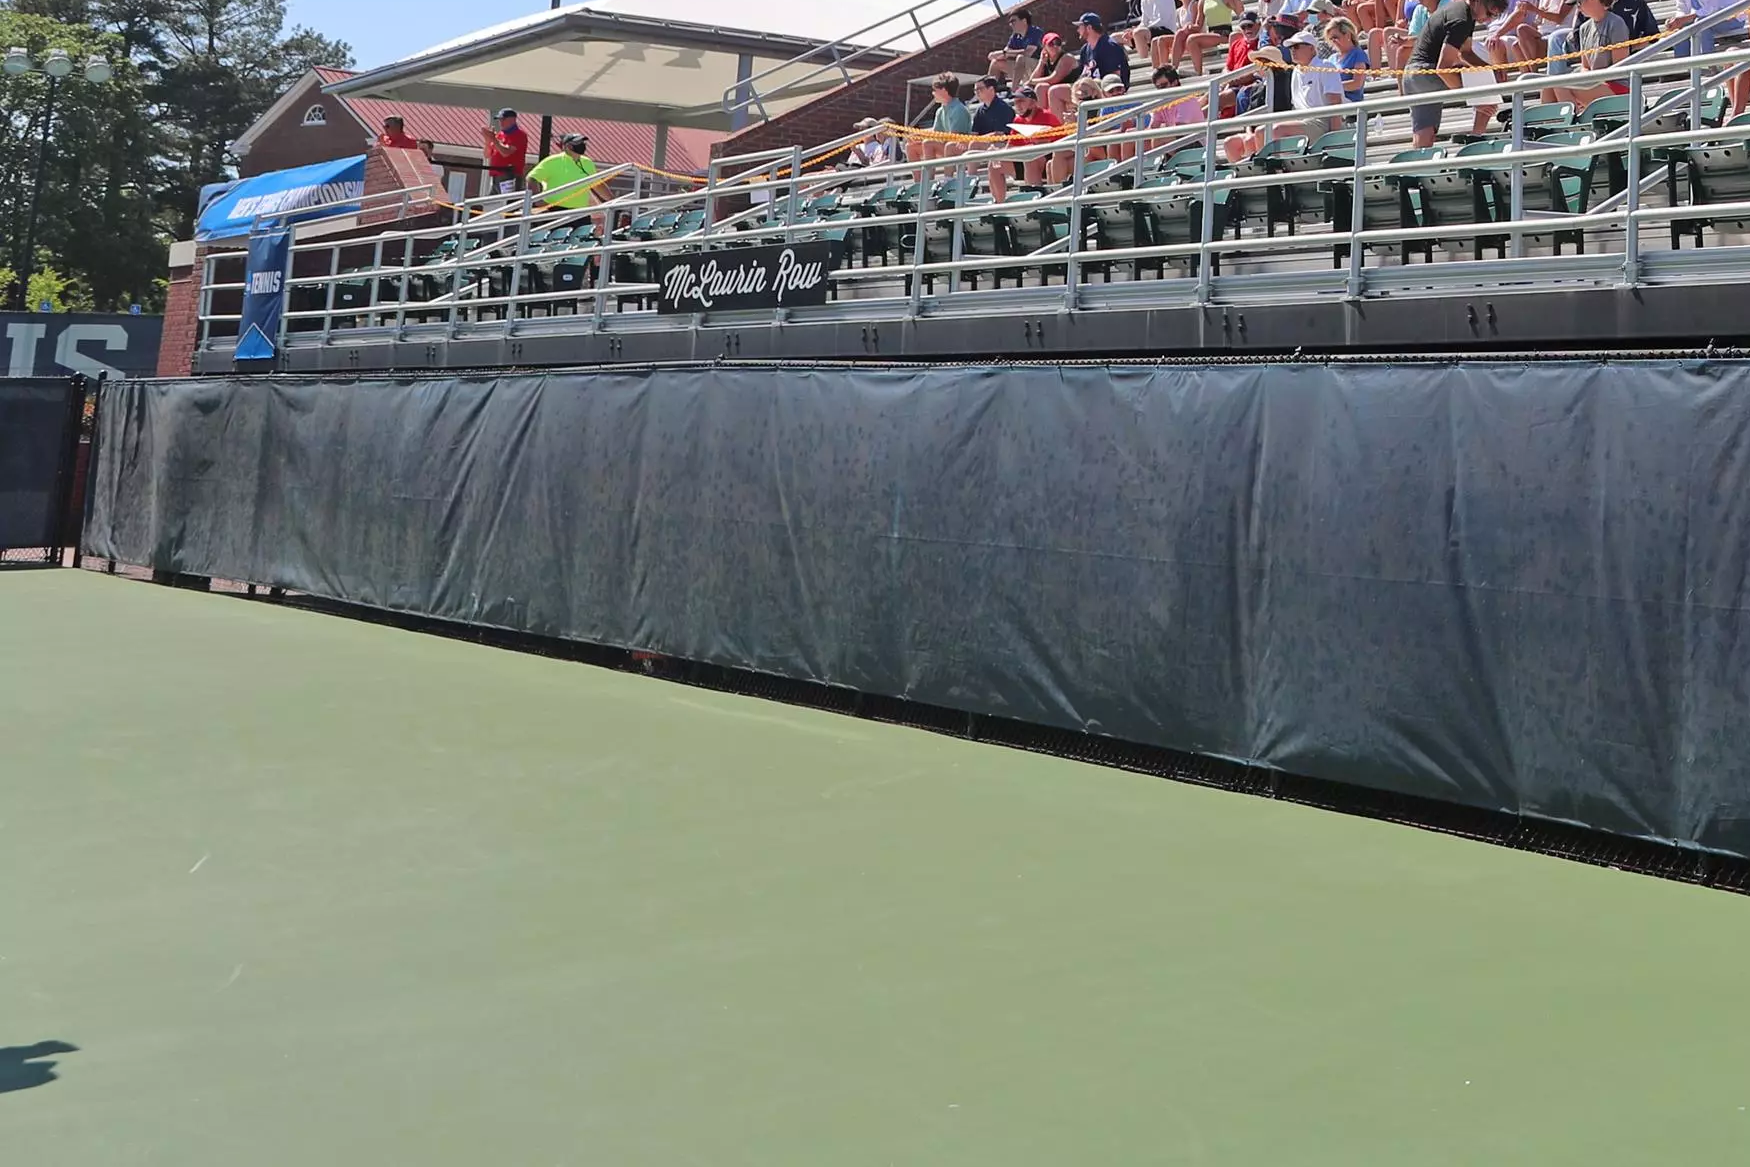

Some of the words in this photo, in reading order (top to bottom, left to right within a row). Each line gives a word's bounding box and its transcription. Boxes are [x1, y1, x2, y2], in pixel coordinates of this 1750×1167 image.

[251, 271, 281, 294] TENNIS
[664, 259, 767, 309] McLaurin
[772, 249, 822, 302] Row
